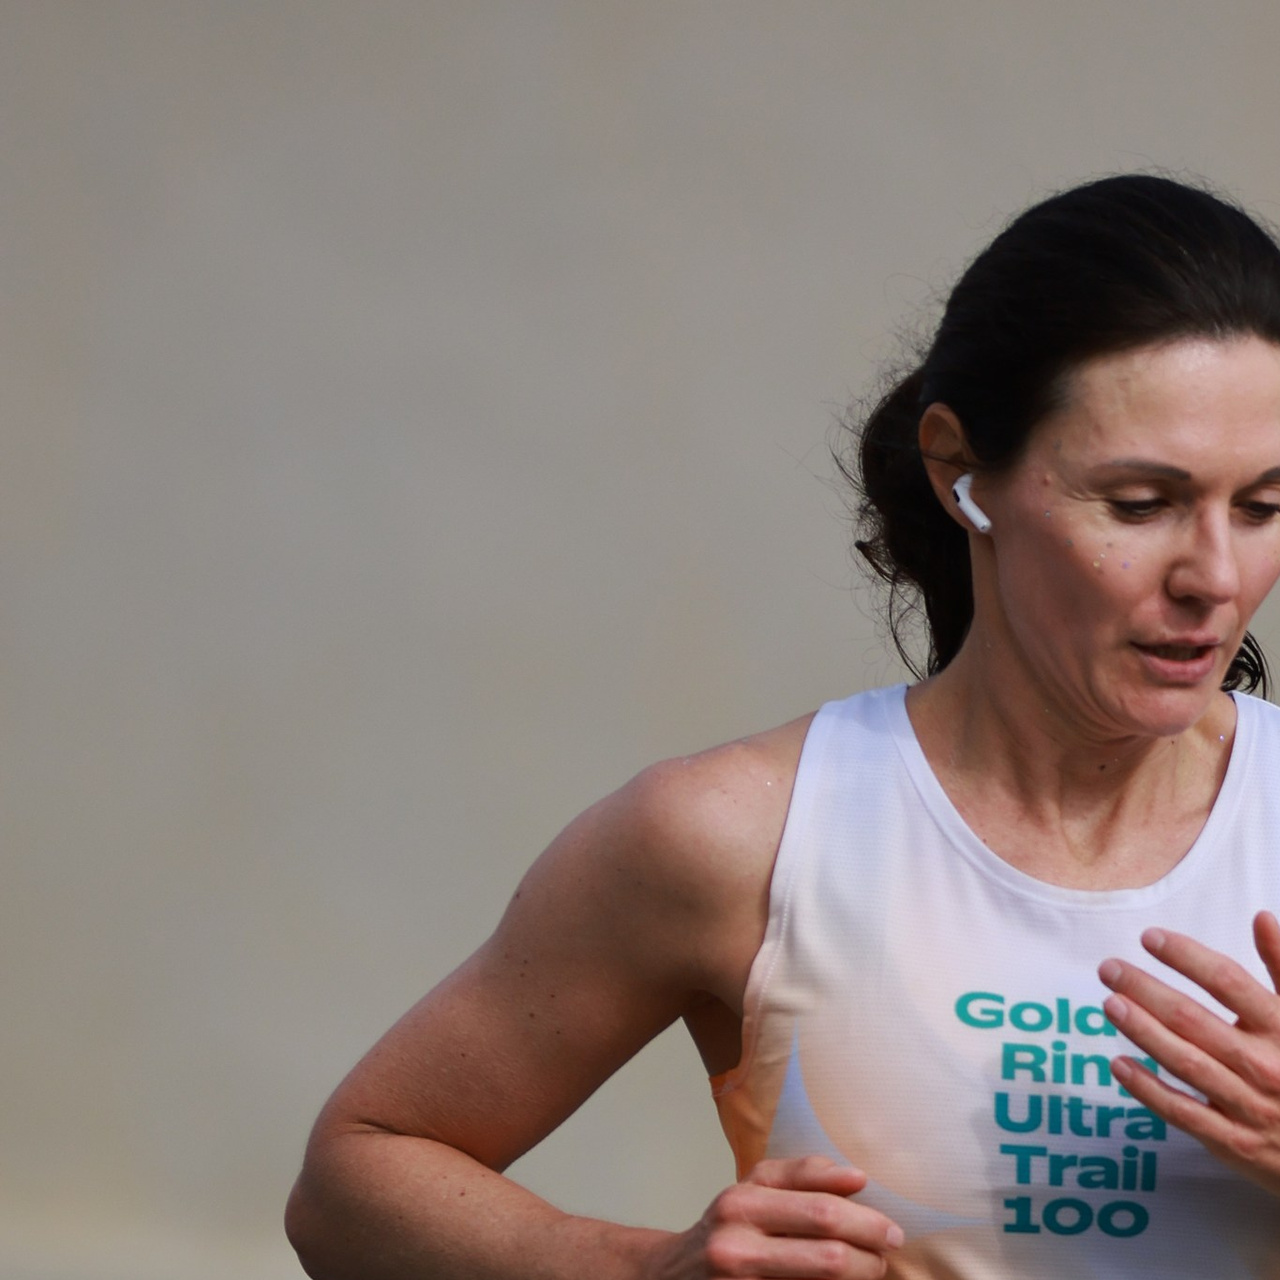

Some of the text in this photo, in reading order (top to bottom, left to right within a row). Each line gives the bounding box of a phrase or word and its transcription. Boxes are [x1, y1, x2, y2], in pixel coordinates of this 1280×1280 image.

[994, 1092, 1167, 1141] Ultra
[1000, 1143, 1157, 1192] Trail
[1003, 1196, 1150, 1238] 100
